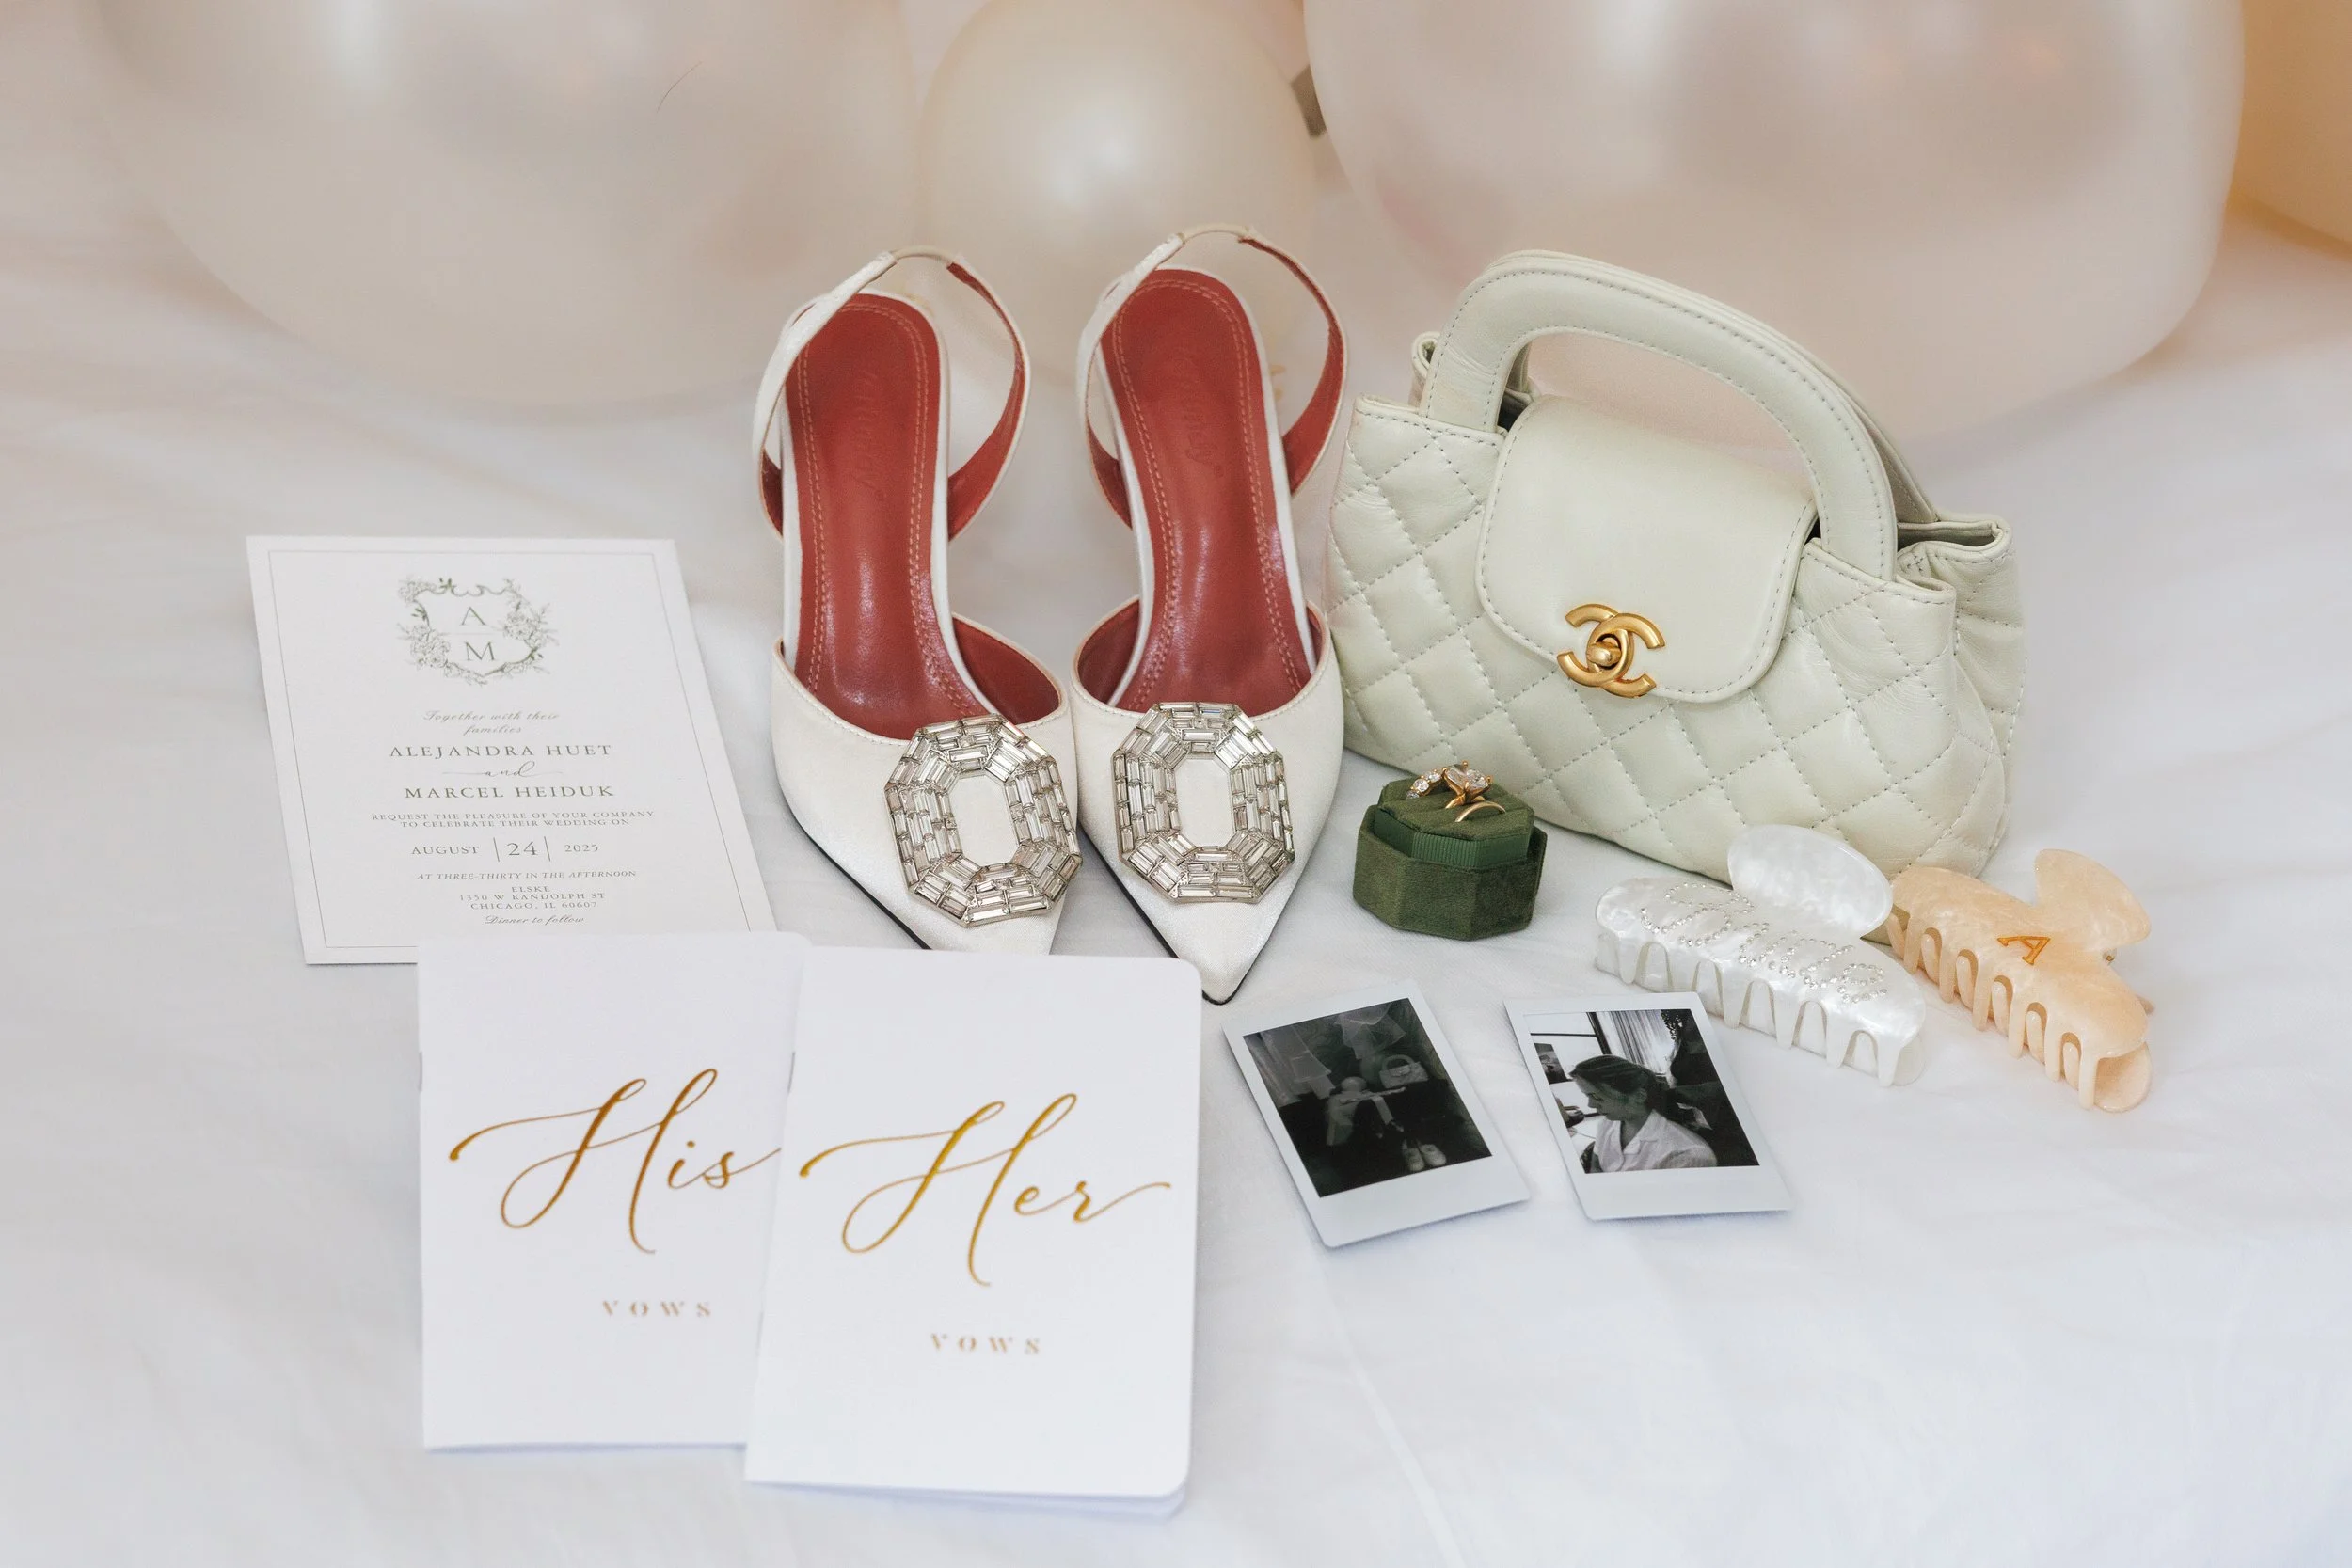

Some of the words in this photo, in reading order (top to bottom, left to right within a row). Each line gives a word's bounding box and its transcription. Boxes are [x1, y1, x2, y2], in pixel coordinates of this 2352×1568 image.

[459, 606, 488, 626] A
[463, 641, 497, 662] M
[421, 710, 487, 723] Together
[489, 710, 523, 721] with
[525, 710, 561, 721] their
[461, 723, 523, 736] families
[389, 745, 535, 760] ALEJANDRA
[545, 743, 613, 757] HUET
[404, 786, 505, 799] MARCEL
[514, 785, 615, 798] HEIDUK
[371, 813, 428, 822] REQUEST
[464, 812, 527, 820] PLEASURE
[591, 810, 655, 818] COMPANY
[421, 820, 496, 829] CELEBRATE
[410, 846, 481, 855] AUGUST
[505, 841, 539, 856] 24
[564, 844, 599, 853] 2025
[437, 872, 523, 880] THREE-THIRTY
[567, 870, 637, 879] AFTERNOON
[511, 893, 586, 901] RANDOLPH
[484, 915, 530, 925] Dinner
[543, 914, 585, 927] follow
[1996, 934, 2052, 966] A
[448, 1068, 781, 1254] His
[798, 1092, 1171, 1287] Her
[600, 1299, 712, 1319] VOWS
[930, 1332, 1041, 1355] VOWS
